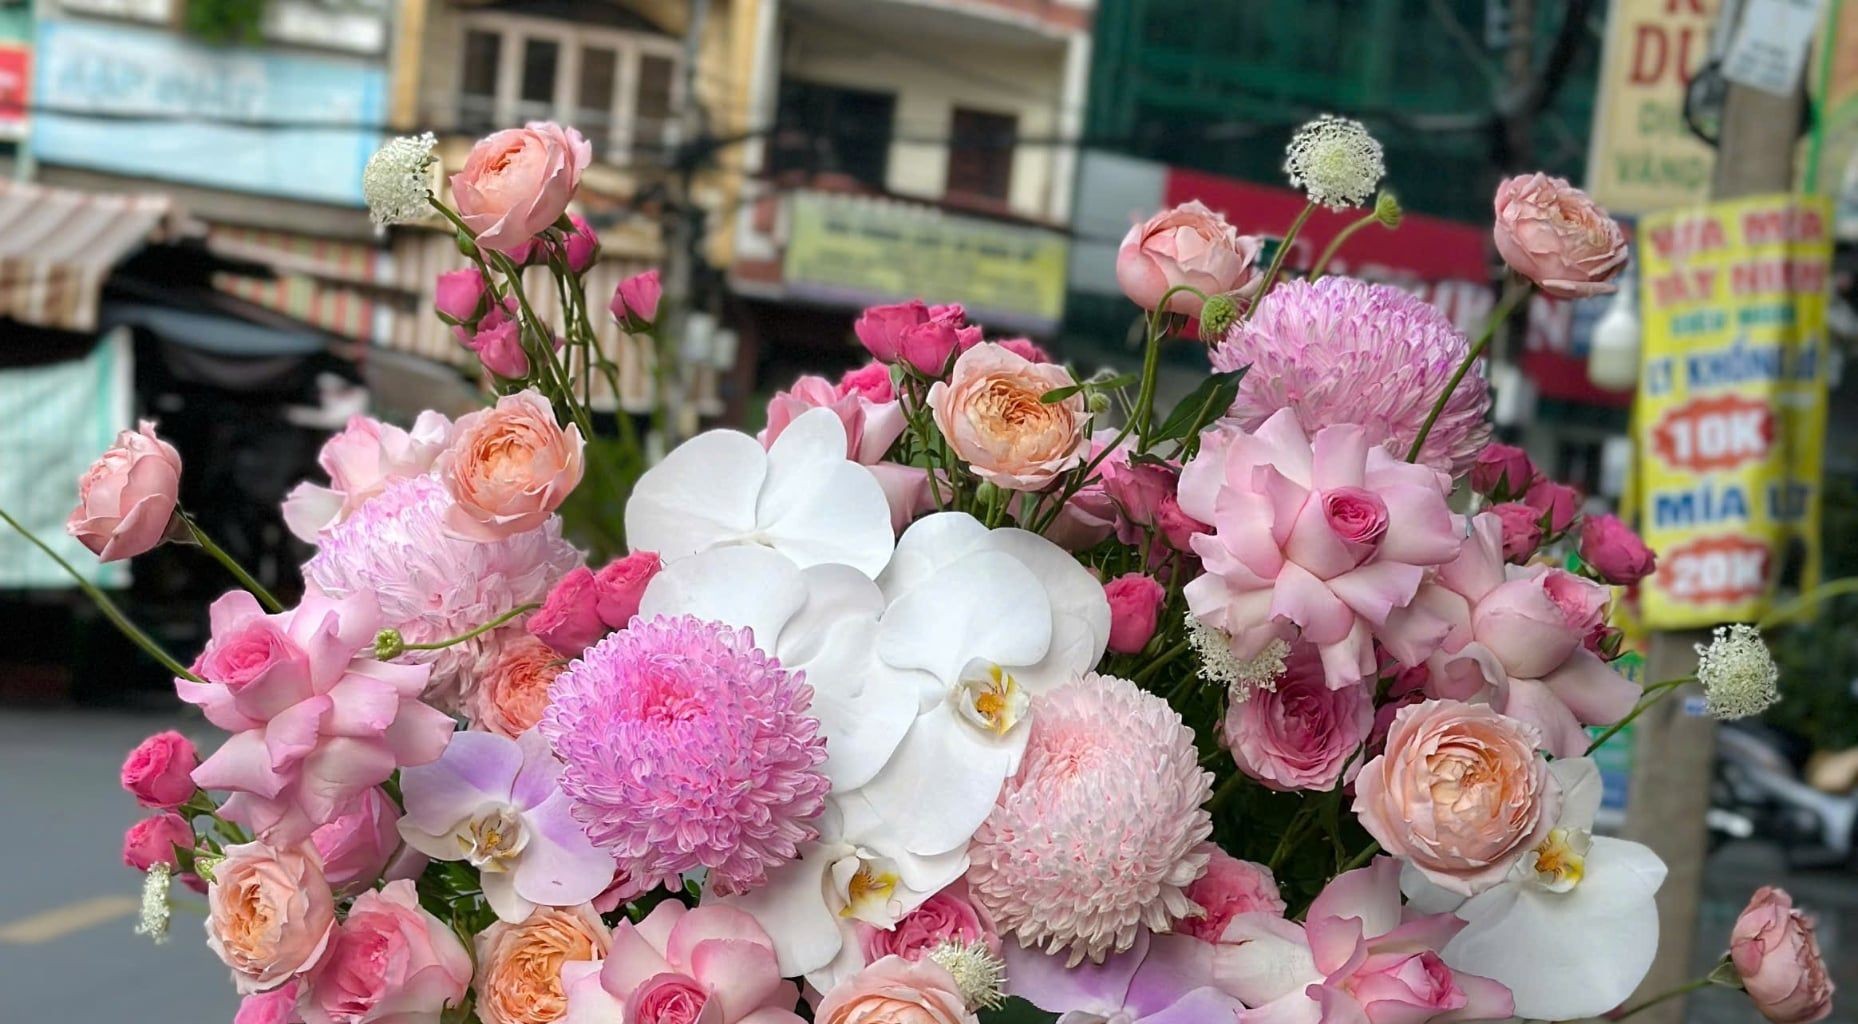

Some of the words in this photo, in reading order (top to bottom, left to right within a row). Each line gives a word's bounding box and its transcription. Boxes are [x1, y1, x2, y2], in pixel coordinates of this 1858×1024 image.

[1669, 409, 1766, 459] 10K
[1655, 482, 1747, 526] MÍA
[1671, 549, 1768, 594] 20K
